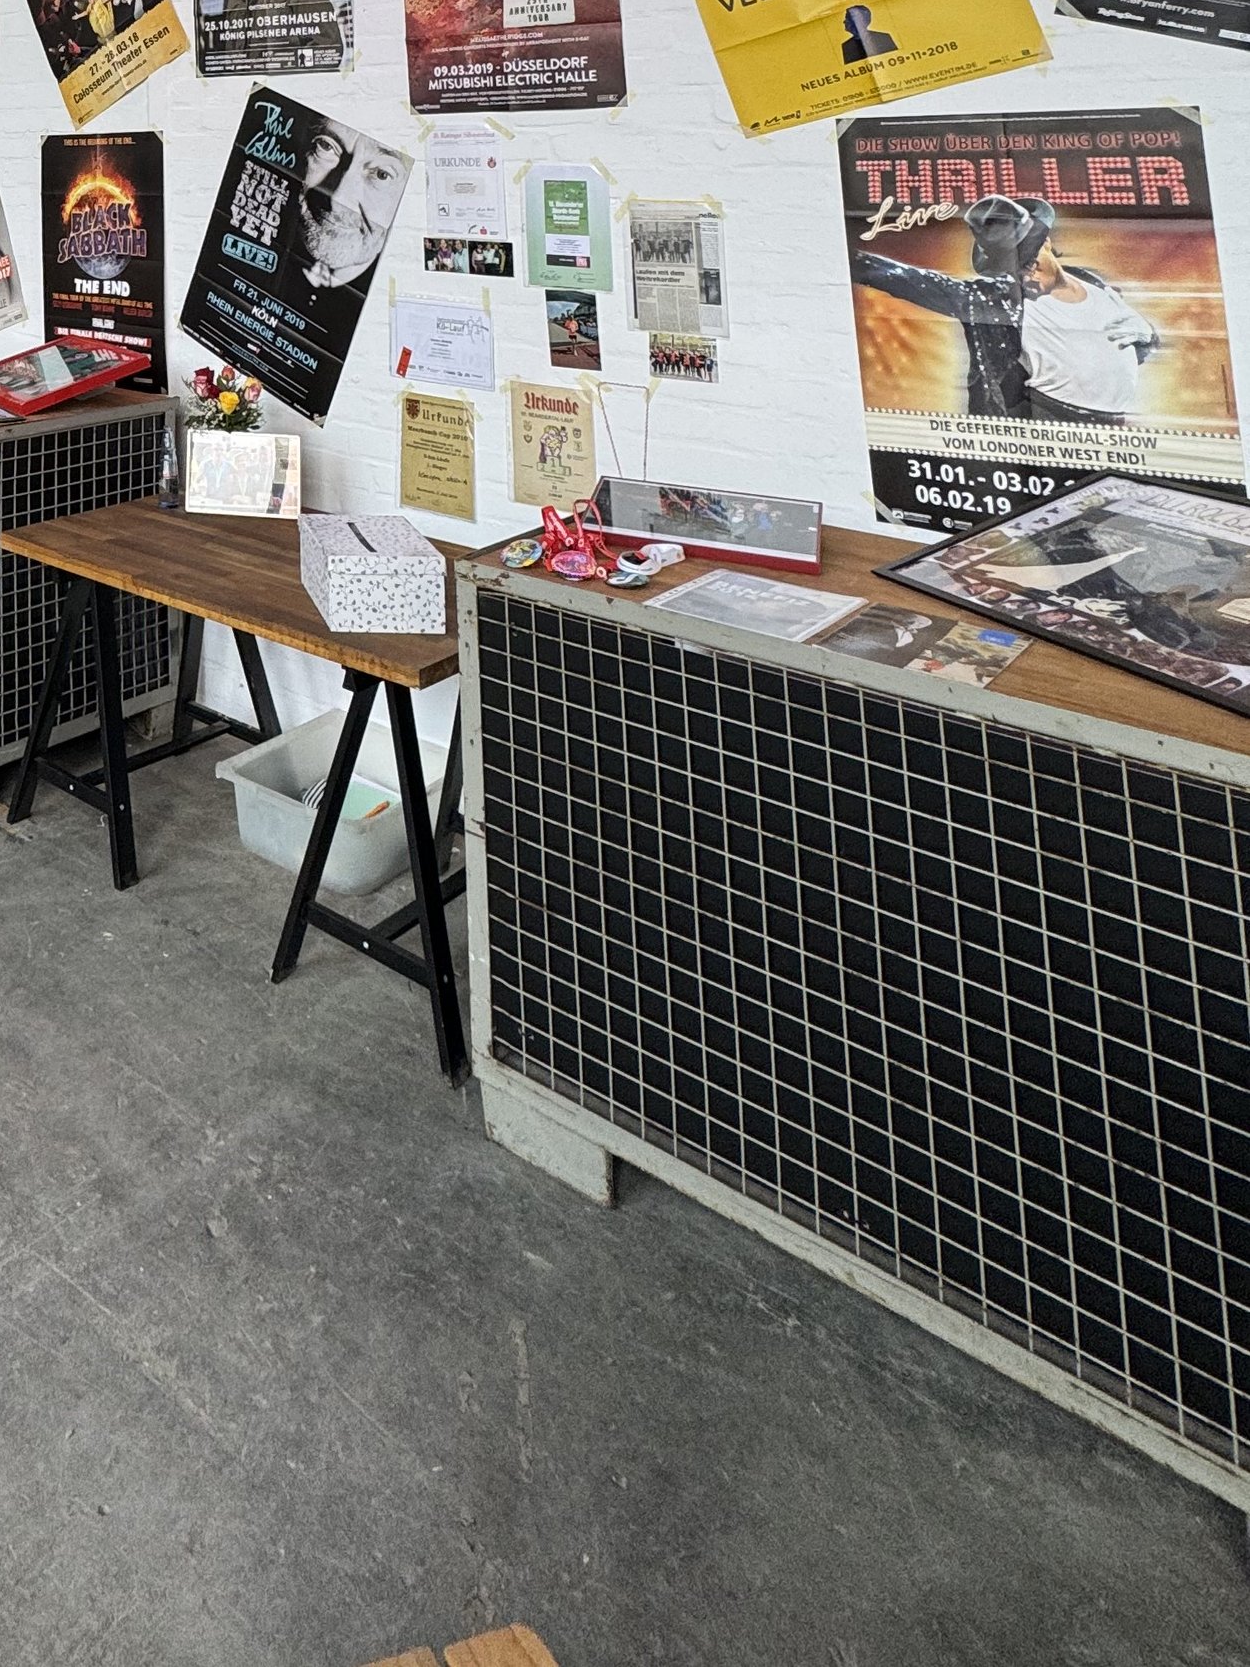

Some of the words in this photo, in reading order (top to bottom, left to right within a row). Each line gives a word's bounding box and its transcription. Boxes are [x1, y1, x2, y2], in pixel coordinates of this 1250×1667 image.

[204, 17, 254, 32] 25.10.2017
[256, 11, 338, 27] OBERHAUSEN
[509, 2, 567, 16] ANNIVERSARY
[527, 13, 550, 23] TOUR
[219, 29, 246, 42] KÖNIG
[246, 27, 288, 40] PILSENER
[289, 26, 321, 36] ARENA
[73, 71, 113, 105] Colosseum
[112, 45, 143, 73] Theater
[142, 25, 171, 50] Essen
[428, 76, 494, 91] MITSUBISHI
[495, 72, 553, 88] ELECTRIC
[555, 69, 598, 85] HALLE
[433, 62, 494, 78] 09.03.2019
[502, 56, 589, 73] DÜSSELDORF
[801, 75, 841, 92] NEUES
[844, 60, 885, 79] ALBUM
[903, 61, 978, 85] WWW.EVENTIM.DE
[254, 101, 295, 139] Phil
[245, 131, 296, 168] Collins
[855, 136, 884, 154] DIE
[889, 135, 939, 153] SHOW
[946, 132, 992, 151] ÜBER
[997, 134, 1036, 151] DEN
[1042, 132, 1092, 149] KING
[1098, 131, 1124, 148] OF
[1130, 129, 1182, 148] POP!
[244, 160, 290, 196] STILL
[434, 157, 481, 168] URKUNDE
[237, 173, 290, 213] NOT
[855, 155, 1191, 207] THRILLER
[70, 200, 134, 235] BLACK
[229, 204, 279, 247] YET
[233, 192, 282, 228] DEAD
[859, 195, 958, 242] Live
[57, 227, 147, 264] SABBATH
[223, 237, 276, 270] LIVE!
[73, 277, 100, 295] THE
[102, 279, 131, 297] END
[232, 279, 247, 294] FR
[247, 288, 259, 302] 21.
[260, 296, 284, 317] JUNI
[283, 309, 306, 331] 2019
[251, 305, 279, 329] KÖLN
[206, 291, 235, 316] RHEIN
[234, 309, 276, 342] ENERGIE
[275, 336, 318, 370] STADION
[523, 391, 580, 416] Urkunde
[929, 419, 953, 433] DIE
[955, 421, 1028, 439] GEFEIERTE
[1030, 427, 1158, 450] ORIGINAL-SHOW
[942, 436, 976, 452] VOM
[979, 439, 1057, 459] LONDONER
[1059, 447, 1102, 463] WEST
[1106, 451, 1147, 466] END!
[915, 483, 1012, 516] 06.02.19
